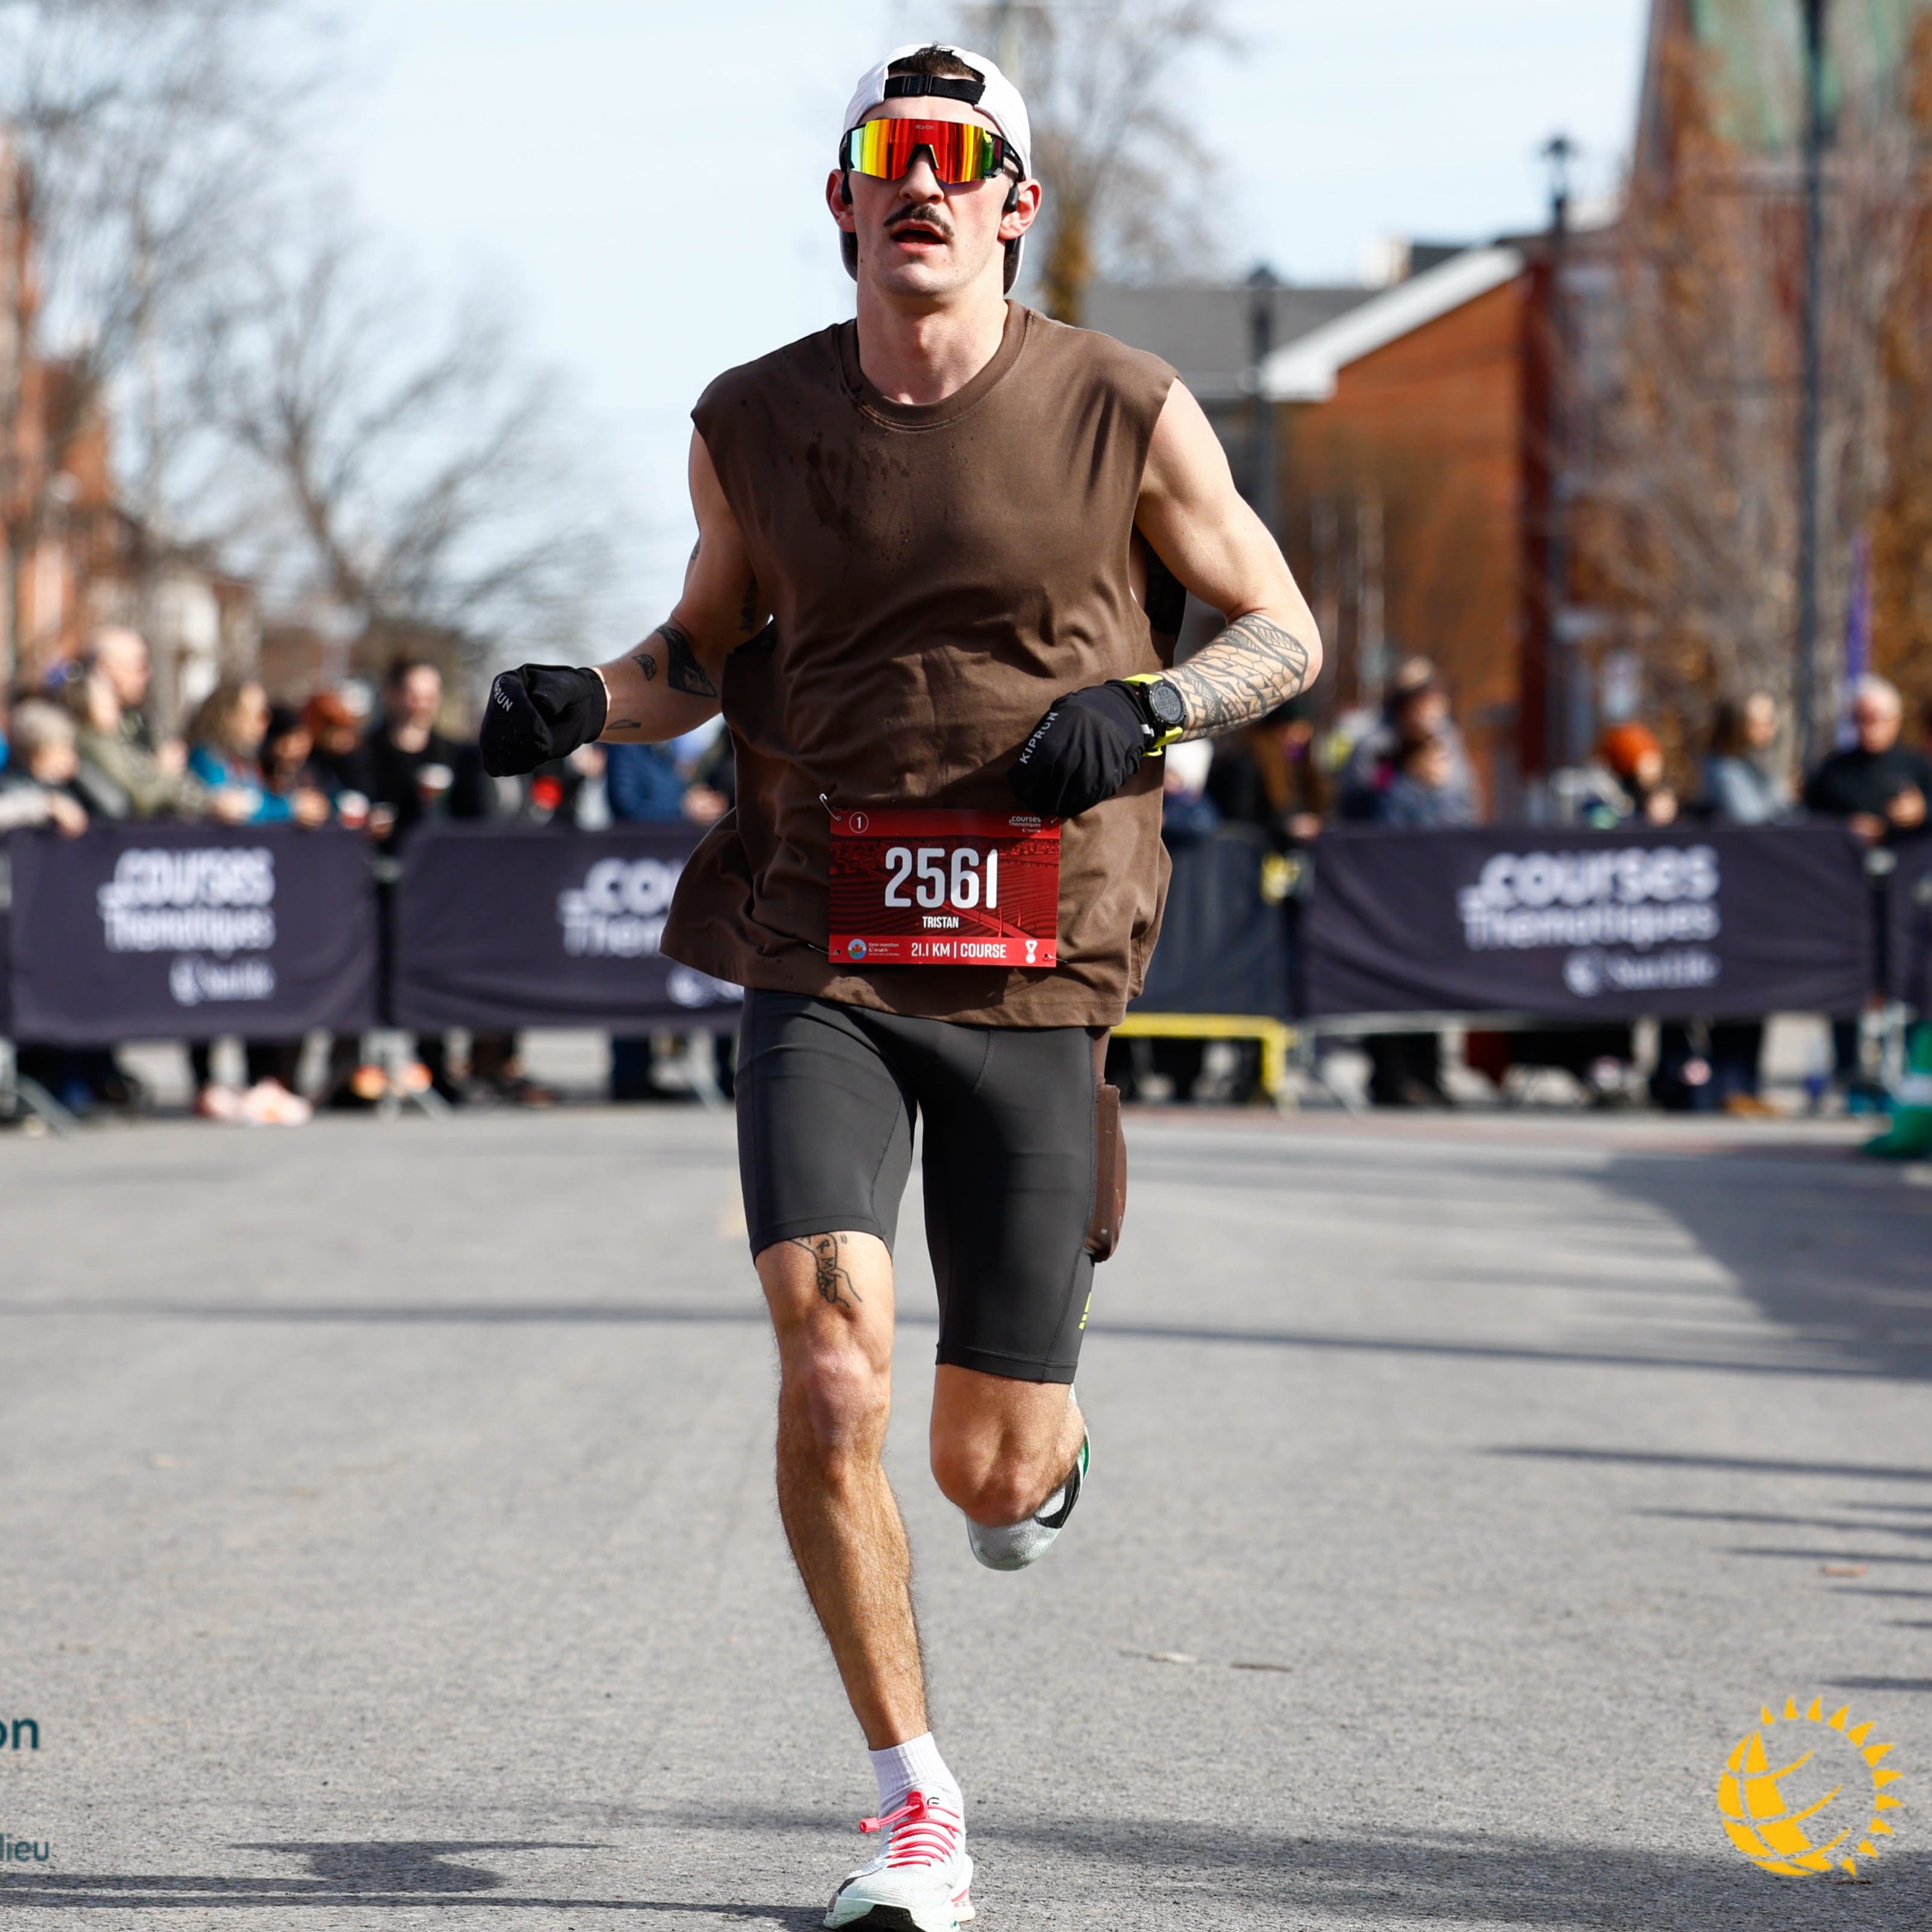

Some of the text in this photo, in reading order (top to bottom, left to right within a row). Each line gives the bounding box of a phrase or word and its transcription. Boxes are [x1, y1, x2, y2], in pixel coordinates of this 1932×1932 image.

[1019, 712, 1059, 764] KIPRUN
[1011, 815, 1041, 823] courses
[884, 846, 998, 909] 2561
[922, 916, 959, 928] TRISTAN
[910, 942, 929, 957] 21.1
[932, 943, 950, 957] KM
[960, 943, 1007, 959] COURSE
